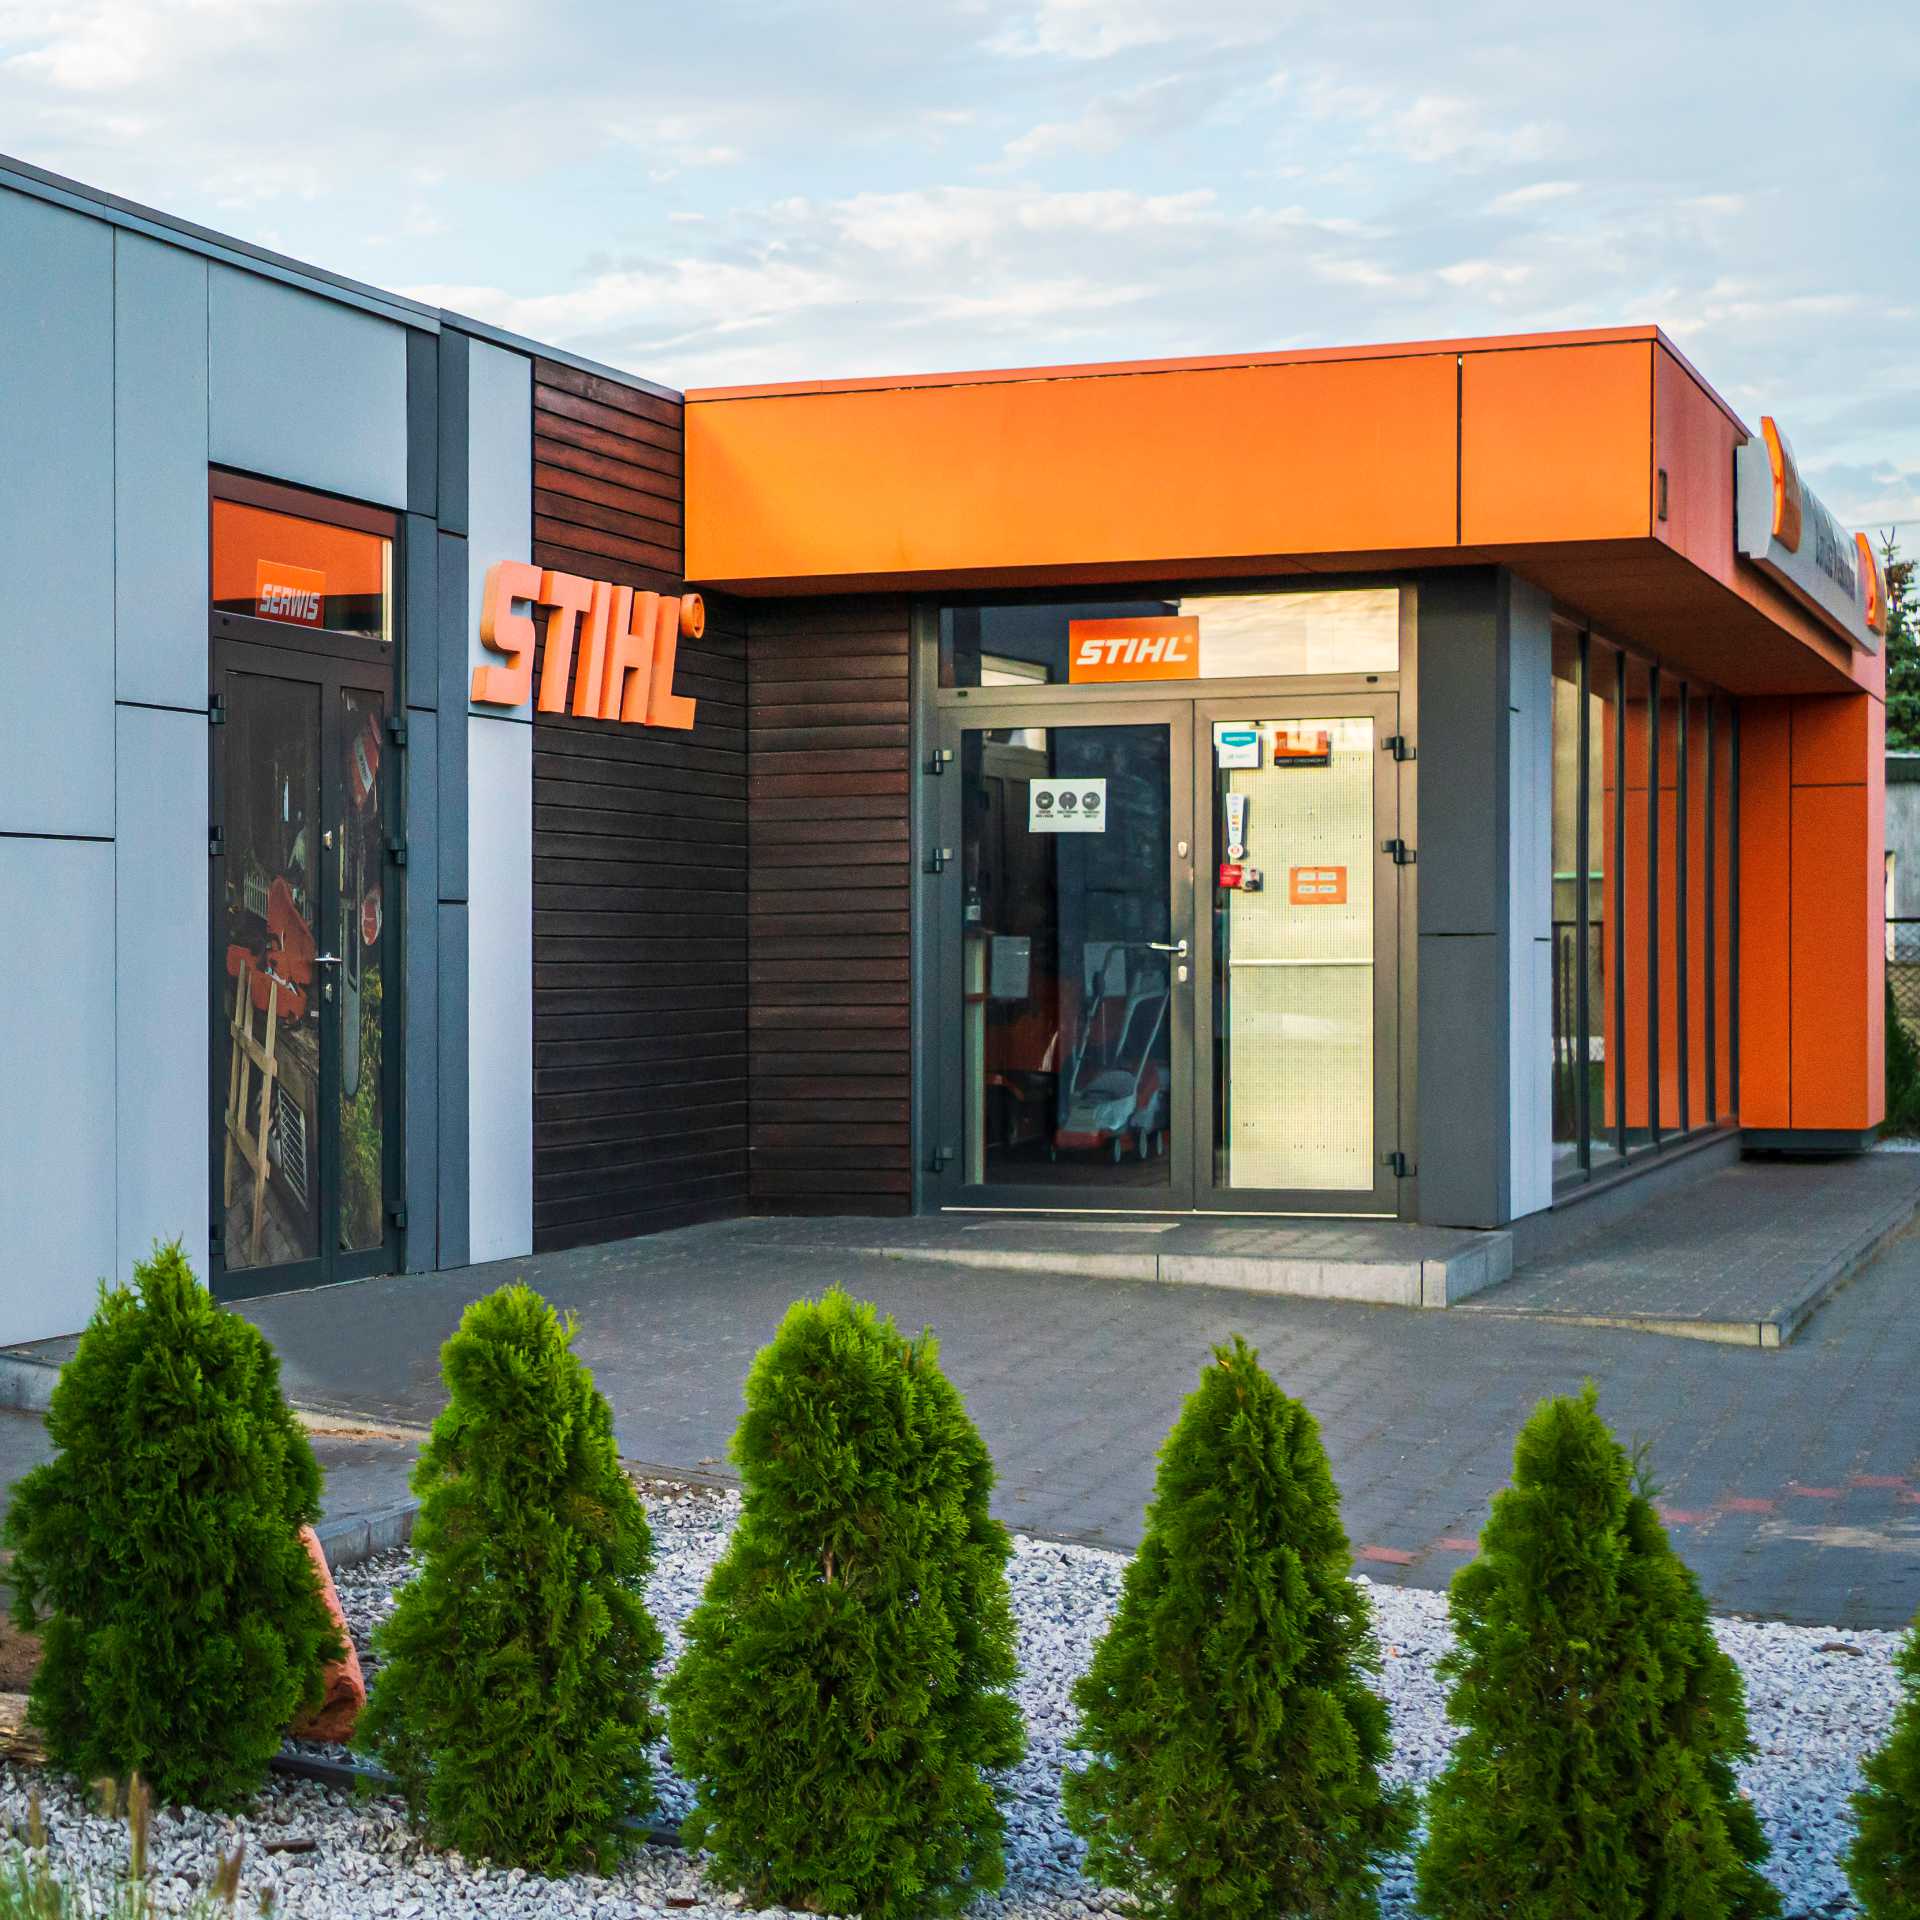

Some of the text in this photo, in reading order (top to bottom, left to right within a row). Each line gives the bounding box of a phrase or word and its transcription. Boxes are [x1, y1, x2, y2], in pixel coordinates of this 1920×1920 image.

[259, 583, 321, 621] SERWIS
[470, 560, 698, 730] STIHL
[1076, 636, 1188, 666] STIHL
